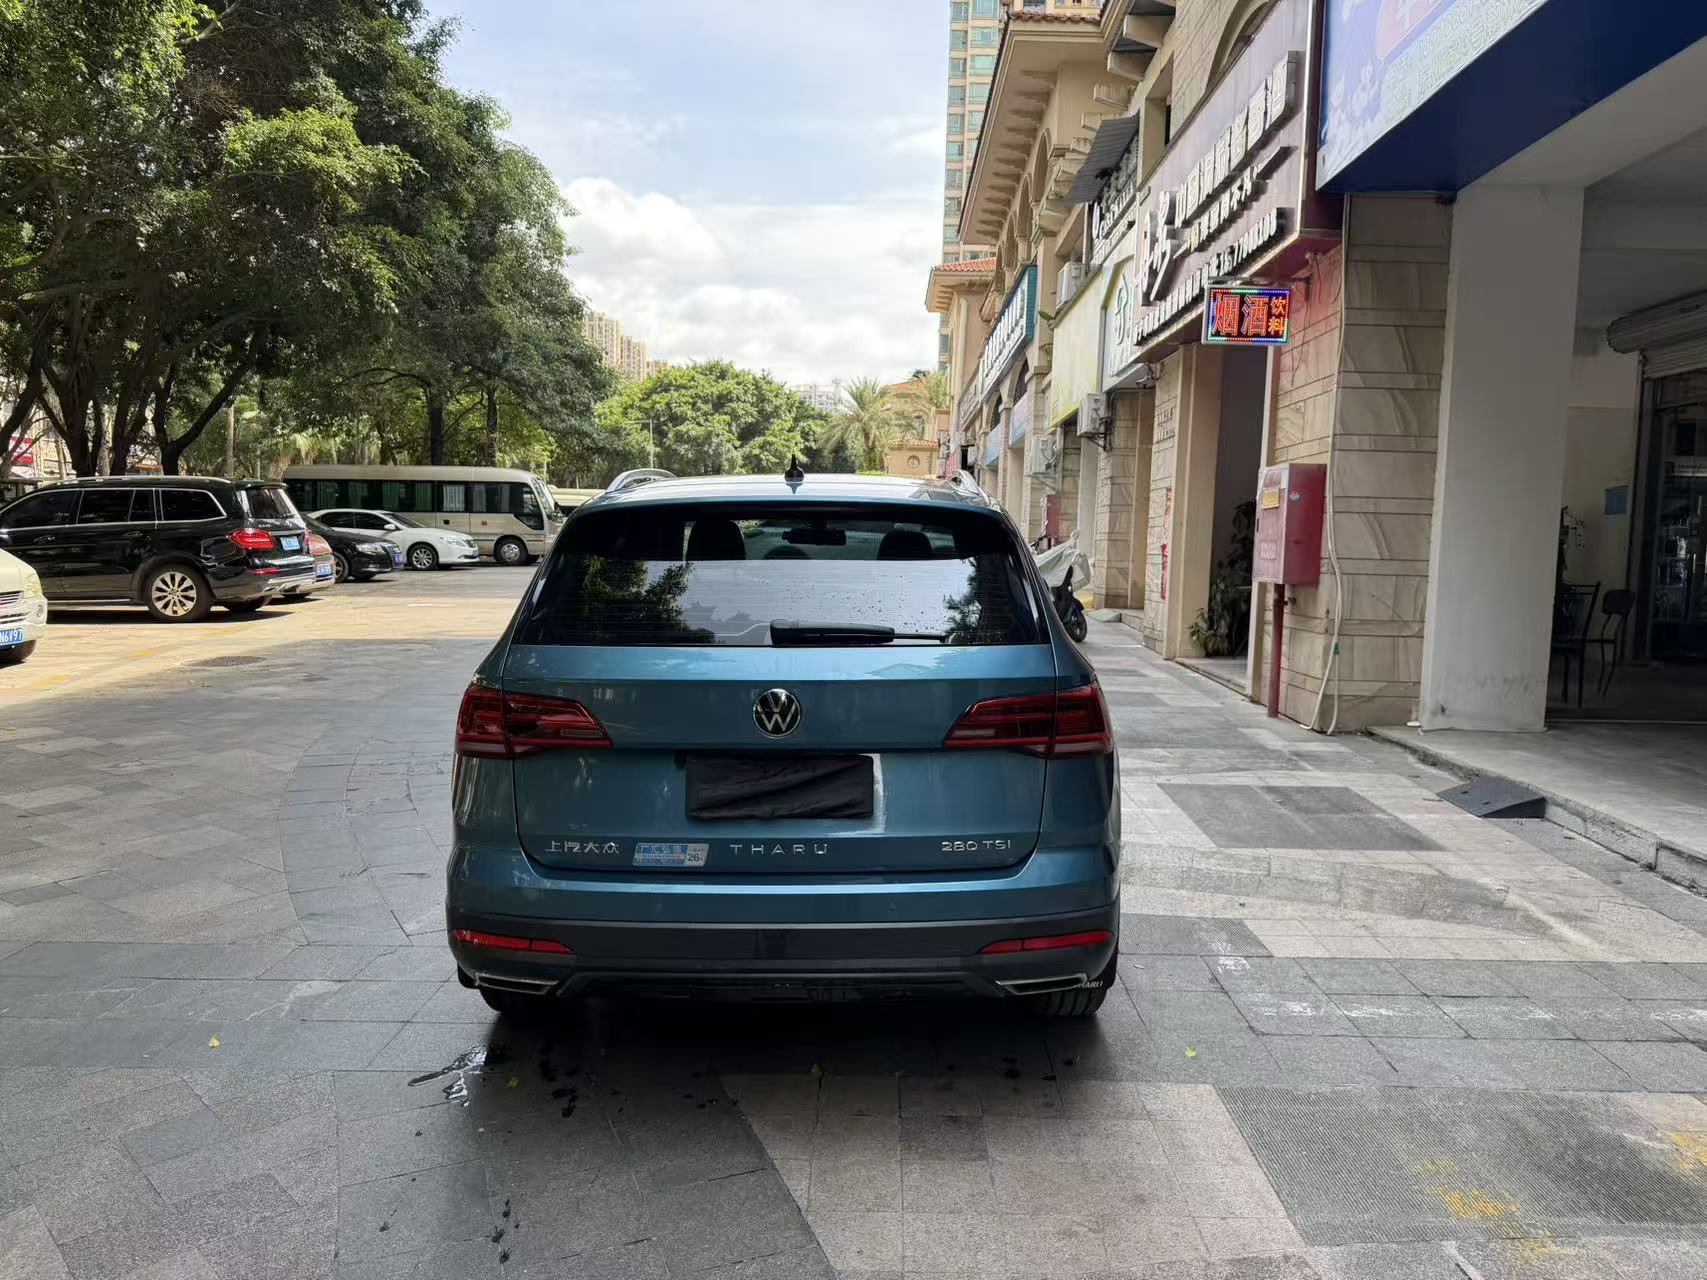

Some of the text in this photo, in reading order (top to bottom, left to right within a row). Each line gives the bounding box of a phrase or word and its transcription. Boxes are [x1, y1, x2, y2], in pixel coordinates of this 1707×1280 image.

[1211, 293, 1270, 336] 烟酒
[1268, 296, 1288, 335] 饮料
[544, 841, 620, 853] 上汽大众
[730, 844, 827, 855] THARU
[941, 840, 1011, 851] 280 TSI
